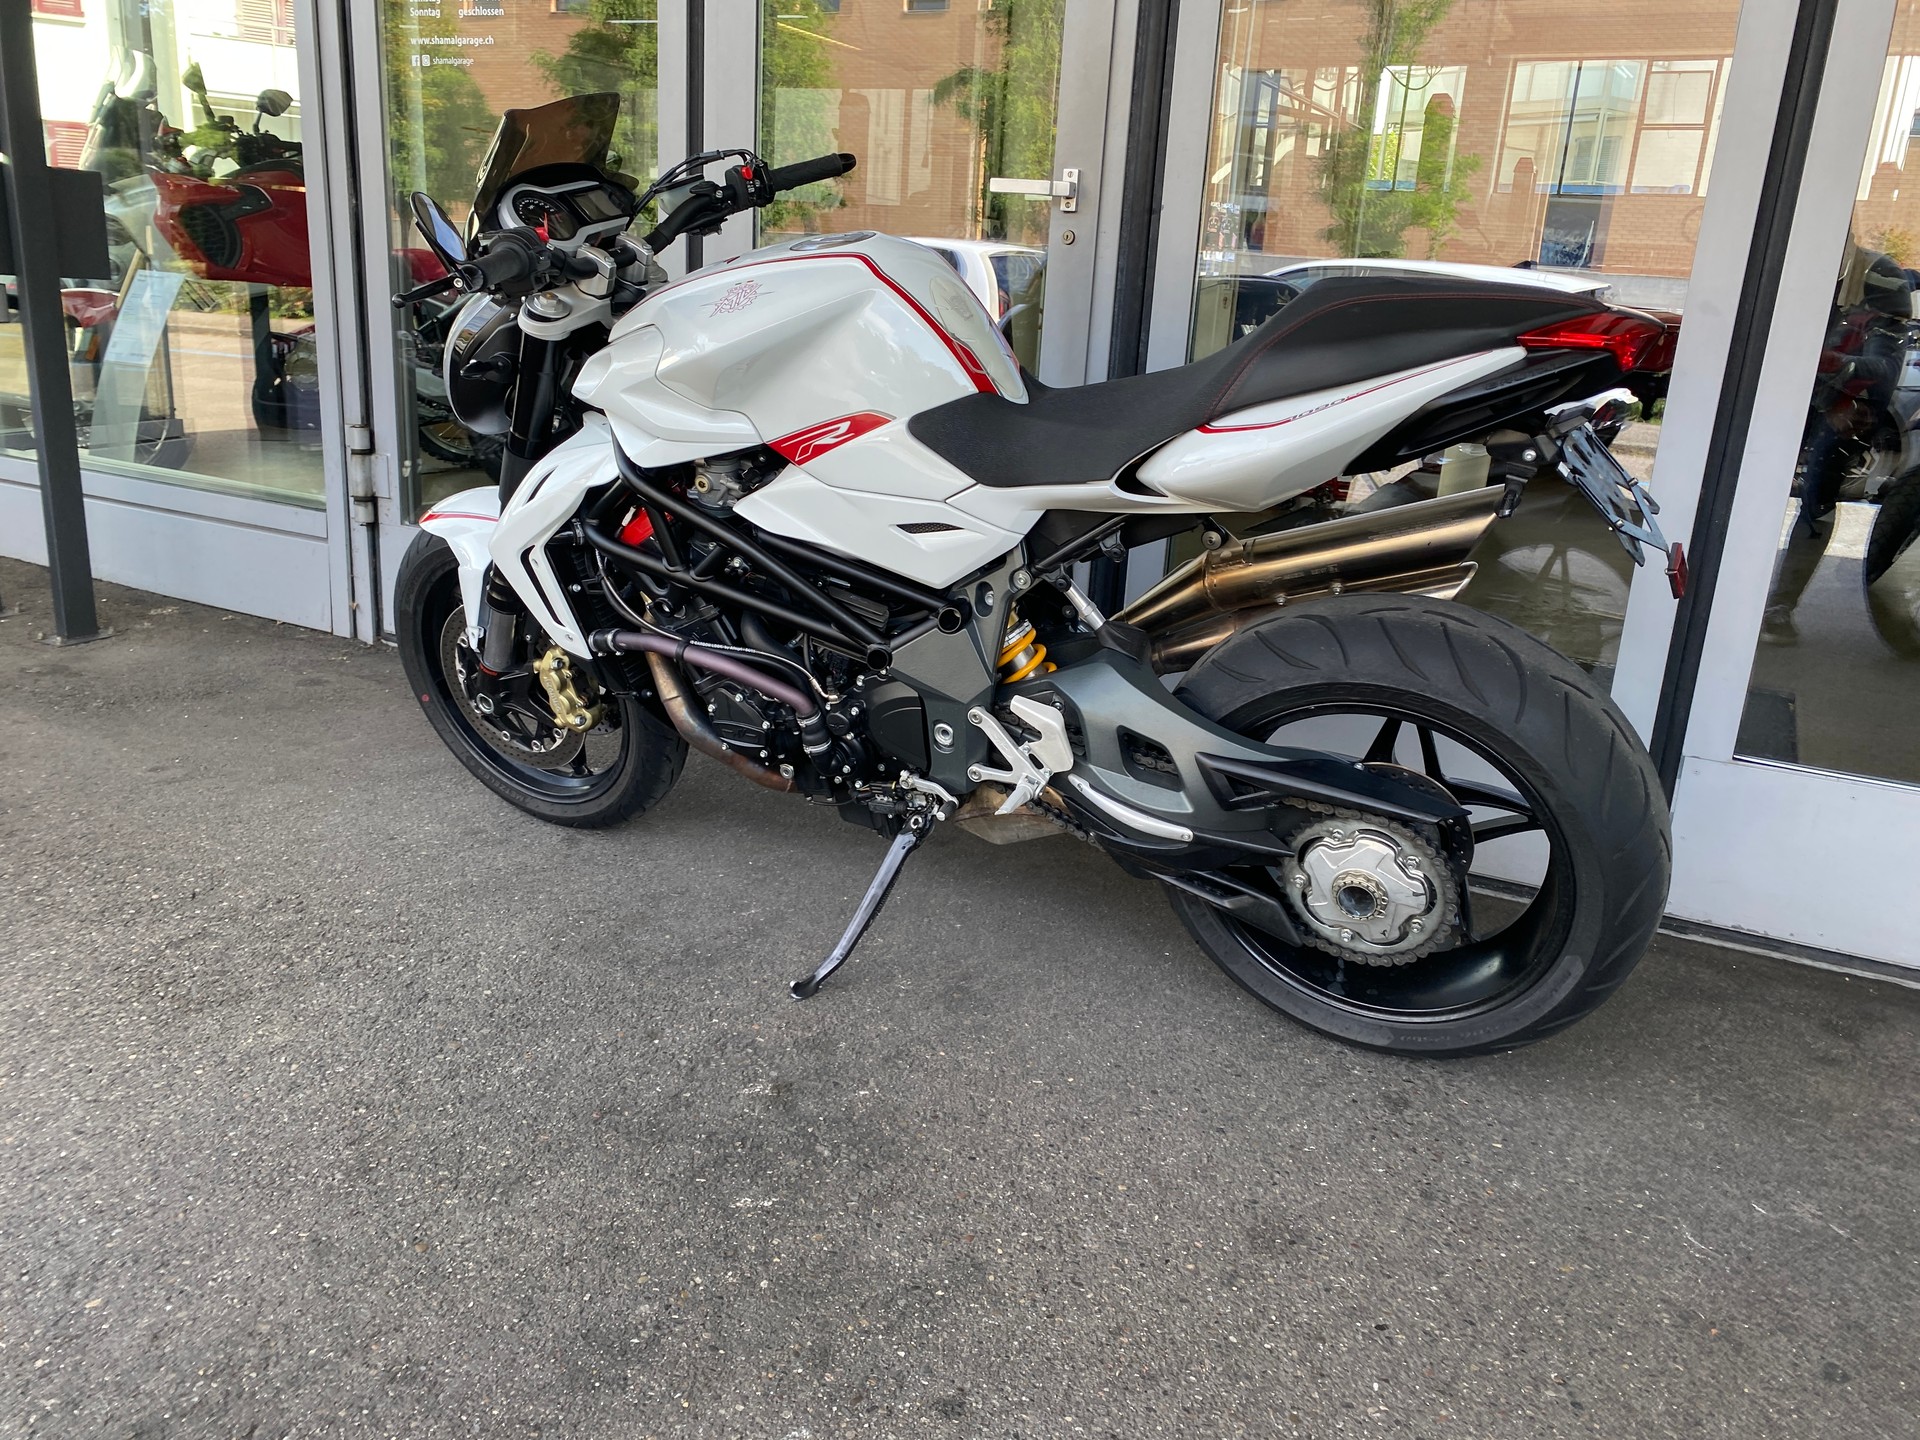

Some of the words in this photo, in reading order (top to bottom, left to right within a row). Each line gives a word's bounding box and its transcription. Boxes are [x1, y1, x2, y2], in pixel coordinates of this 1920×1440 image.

[409, 7, 441, 19] Sonntag
[458, 6, 505, 19] geschlossen
[410, 35, 494, 47] www.shamalgarage.ch
[432, 57, 475, 66] shamalgarage
